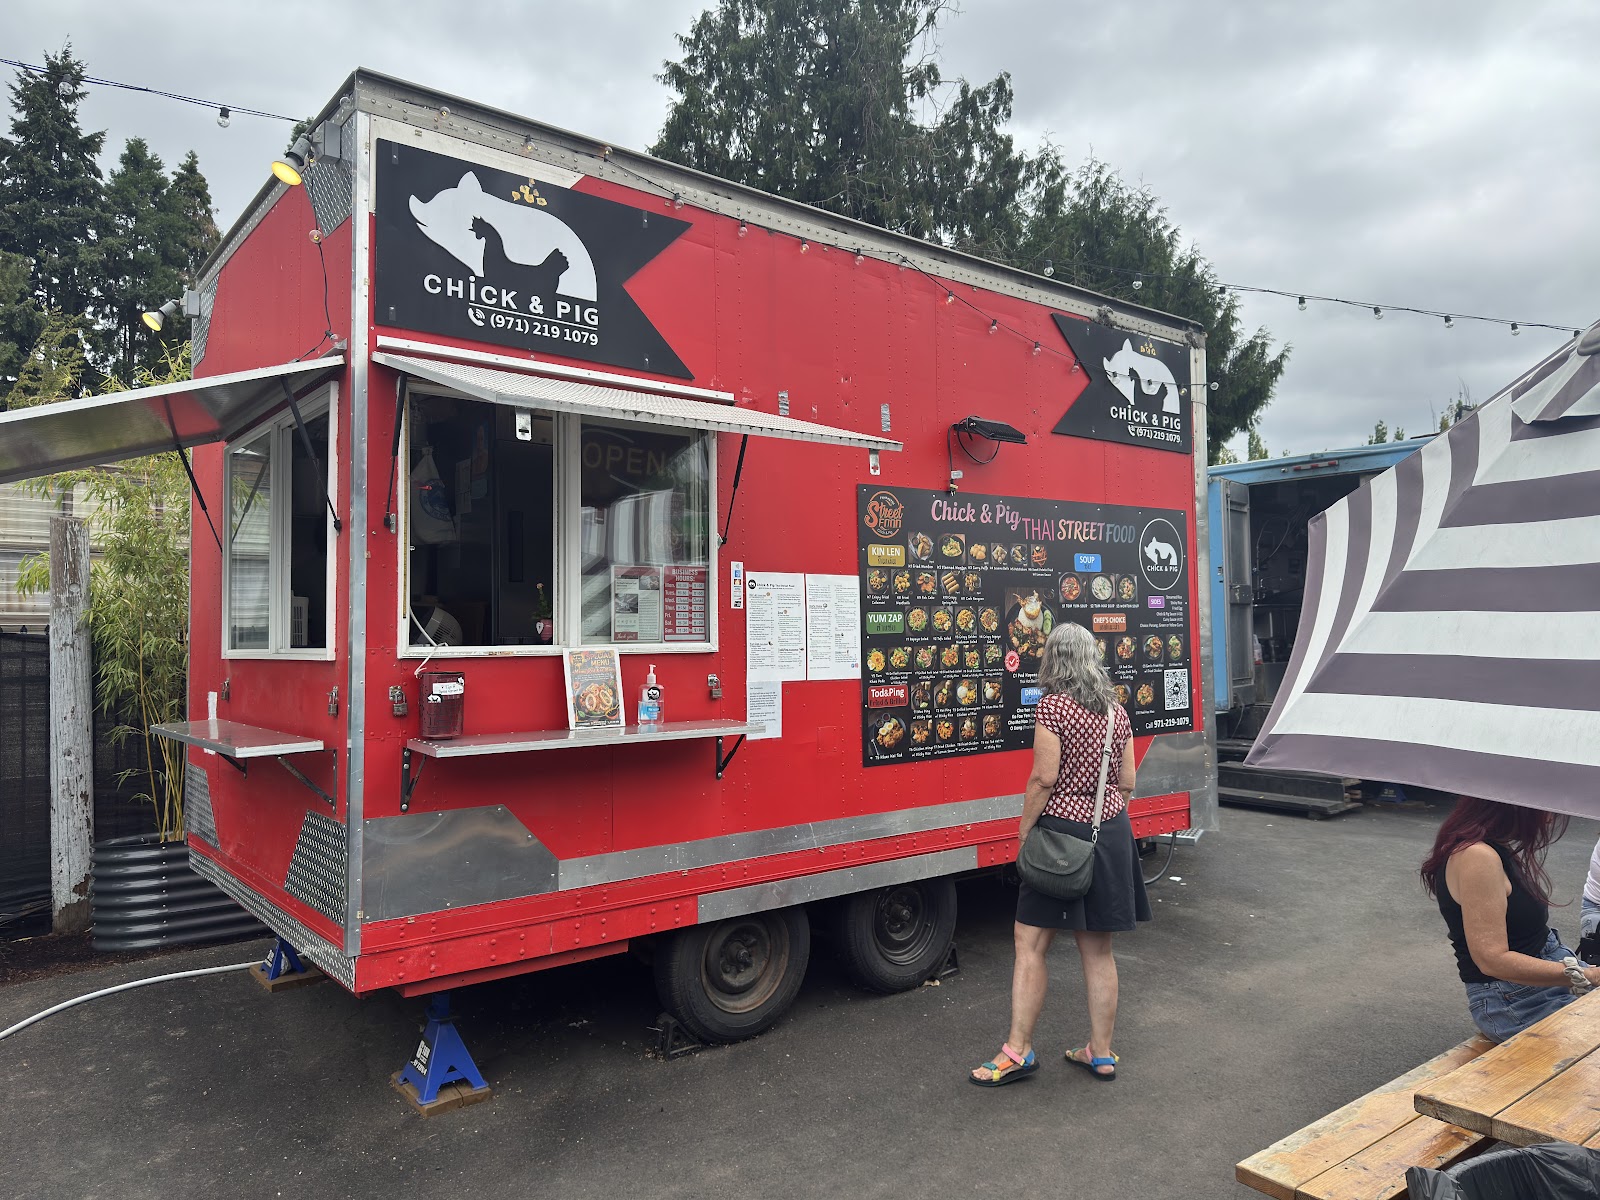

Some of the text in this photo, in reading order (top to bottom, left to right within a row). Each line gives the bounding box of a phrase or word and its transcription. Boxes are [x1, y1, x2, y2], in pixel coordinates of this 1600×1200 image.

[529, 295, 544, 315] &
[556, 300, 599, 326] PIG
[489, 313, 599, 346] (971) 219 1079
[1151, 413, 1159, 426] &
[1162, 415, 1181, 430] PIG
[1136, 428, 1180, 443] (971) 219 1079
[583, 442, 666, 476] OPEN
[931, 499, 1022, 531] Chick & Pig
[1022, 518, 1136, 543] THAI STREET FOOD
[872, 546, 900, 557] KIN LEN
[1079, 555, 1096, 564] SOUP
[868, 614, 902, 623] YUM ZAP
[871, 688, 904, 698] Tod&Ping
[1154, 717, 1189, 728] 971-219-1079
